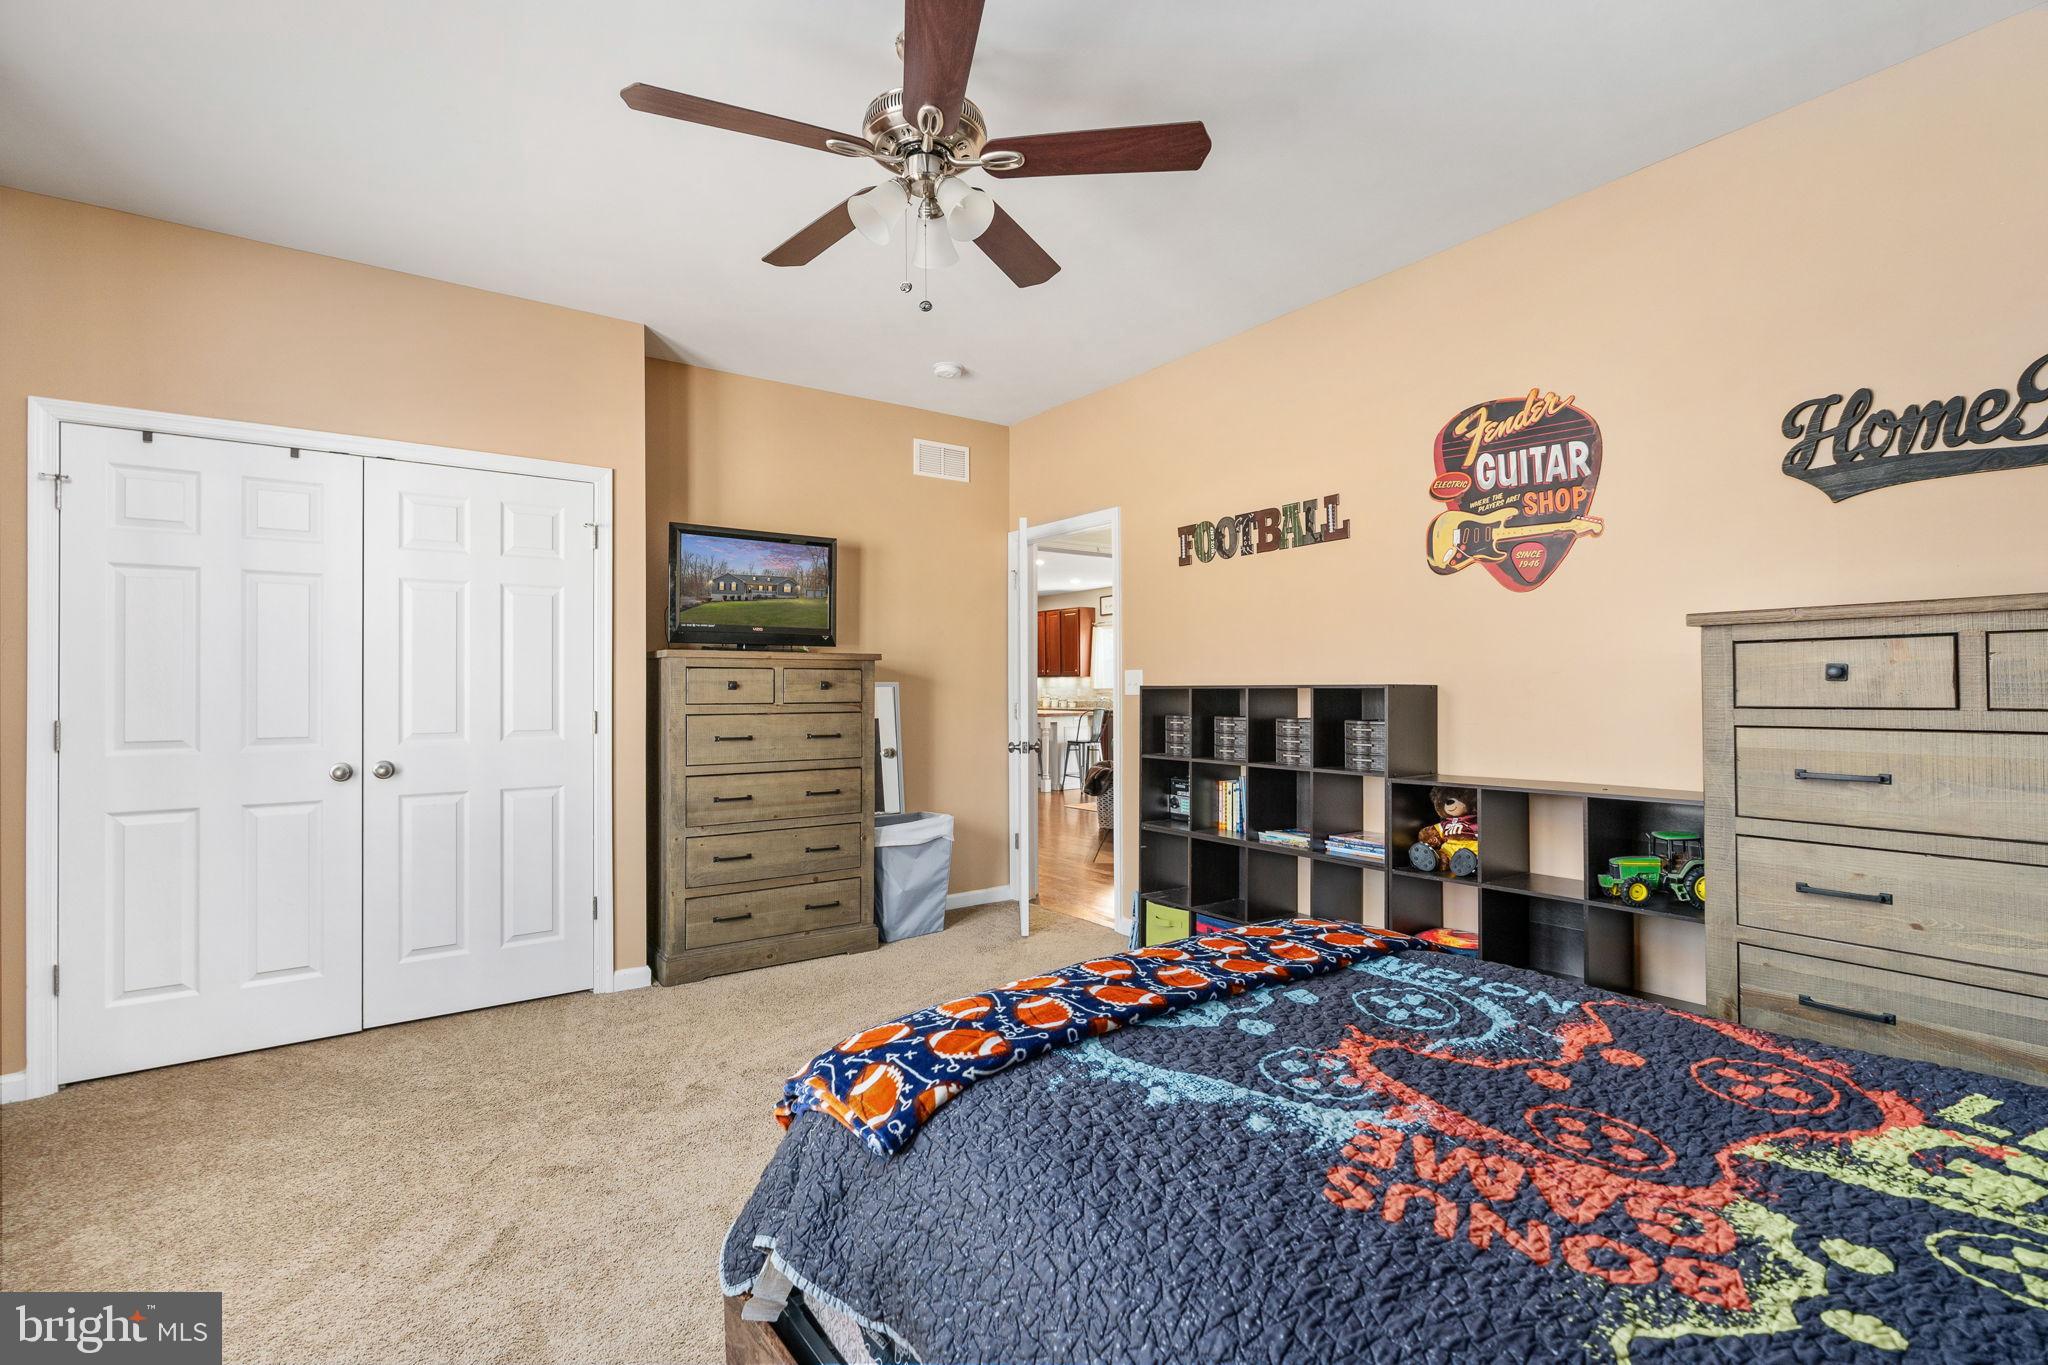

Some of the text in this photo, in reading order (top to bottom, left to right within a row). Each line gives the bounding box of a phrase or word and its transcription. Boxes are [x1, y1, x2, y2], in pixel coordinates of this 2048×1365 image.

[1453, 387, 1576, 468] Fender
[1475, 441, 1592, 490] GUITAR
[1433, 480, 1468, 489] ELECTRIC
[1470, 493, 1504, 508] WHERE THE
[1478, 499, 1504, 512] PLAYERS
[1523, 486, 1587, 515] SHOP
[1178, 493, 1350, 567] FOOTBALL
[1516, 550, 1542, 559] SINCE
[1518, 559, 1540, 568] 1946
[1342, 1121, 1737, 1255] GAME
[1323, 1164, 1752, 1311] BONUS
